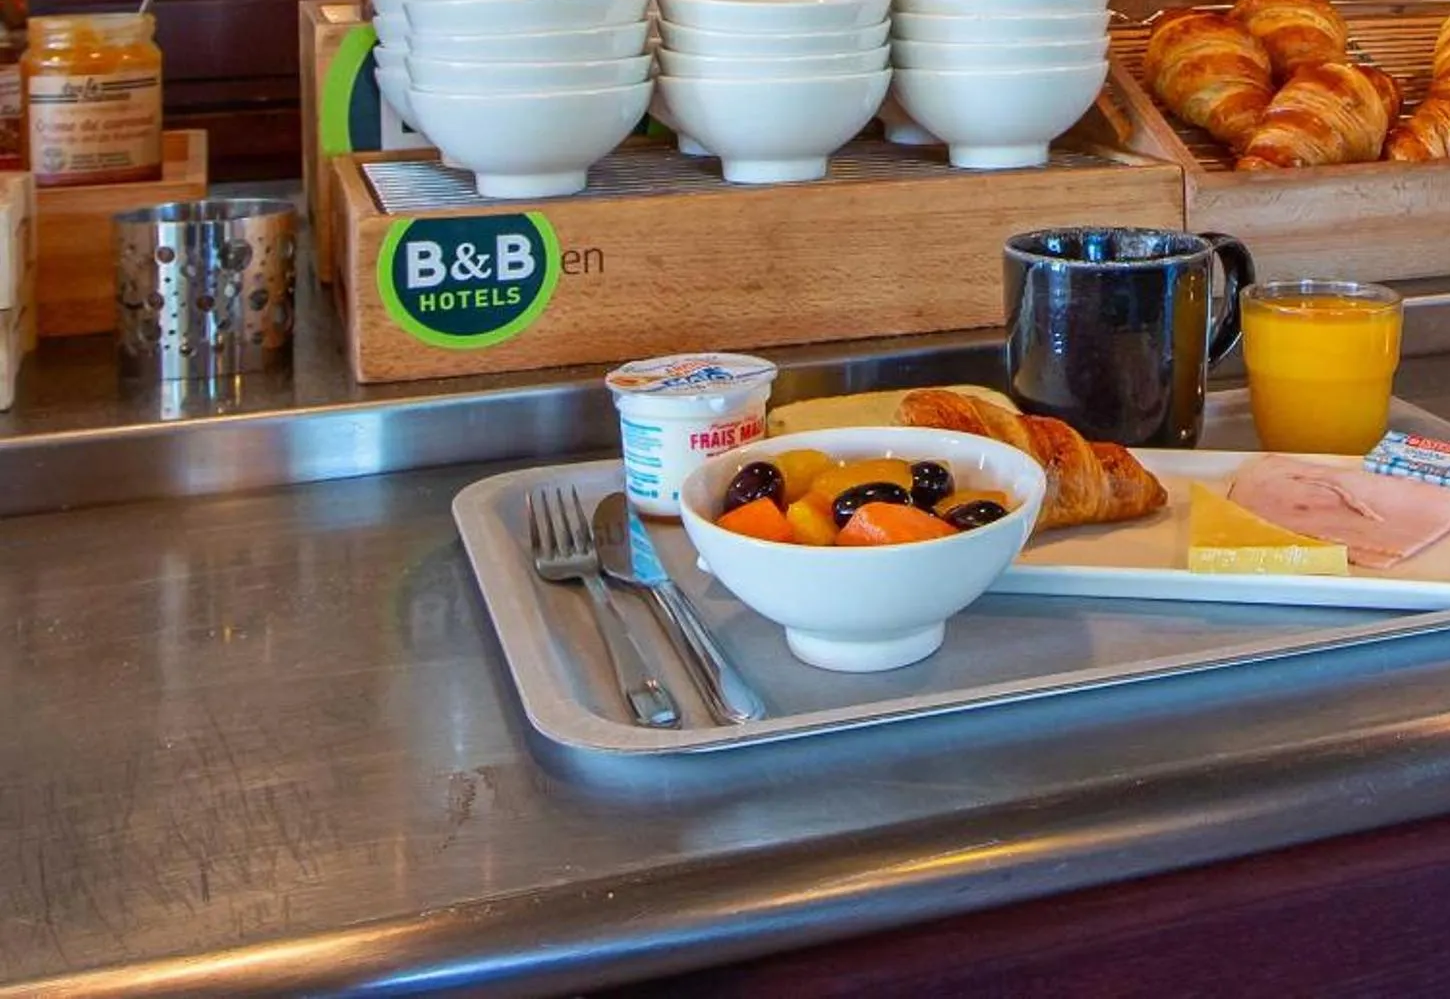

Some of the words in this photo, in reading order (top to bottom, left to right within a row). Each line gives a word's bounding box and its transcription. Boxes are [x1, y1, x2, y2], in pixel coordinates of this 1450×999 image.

[406, 233, 536, 289] B&B
[419, 286, 521, 312] HOTELS
[690, 429, 736, 450] FRAIS
